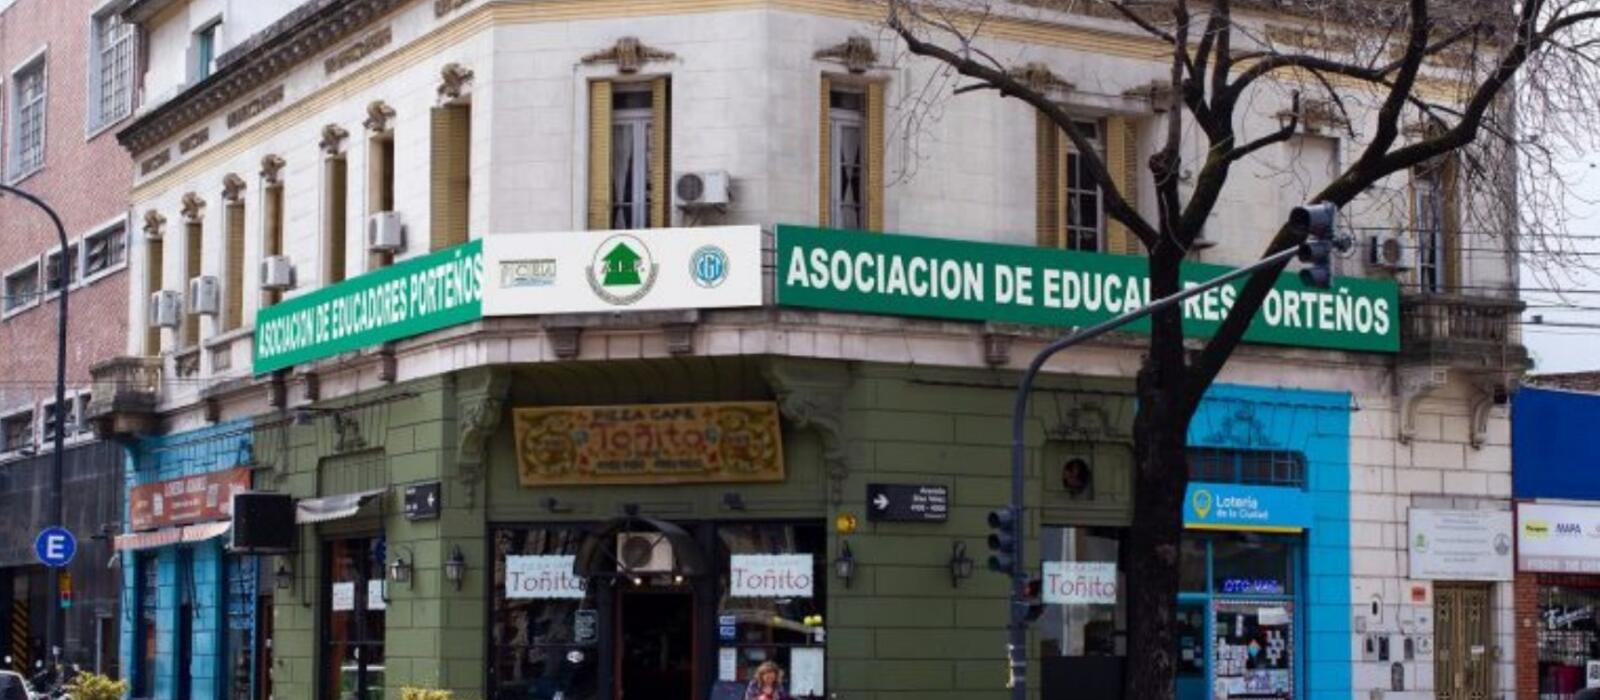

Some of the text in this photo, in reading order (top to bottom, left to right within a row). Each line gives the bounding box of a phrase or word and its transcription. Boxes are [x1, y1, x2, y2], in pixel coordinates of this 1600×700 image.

[259, 308, 315, 357] ASOCIACION
[316, 306, 330, 343] DE
[332, 279, 407, 335] EDUCADORES
[410, 250, 483, 318] PORTEÑOS
[786, 245, 1390, 335] ASOCIACION DE EDUCARES ORTEÑOS
[590, 420, 704, 454] Toñito
[47, 536, 64, 559] E
[732, 568, 810, 590] Toñito
[1048, 574, 1117, 598] Toñito
